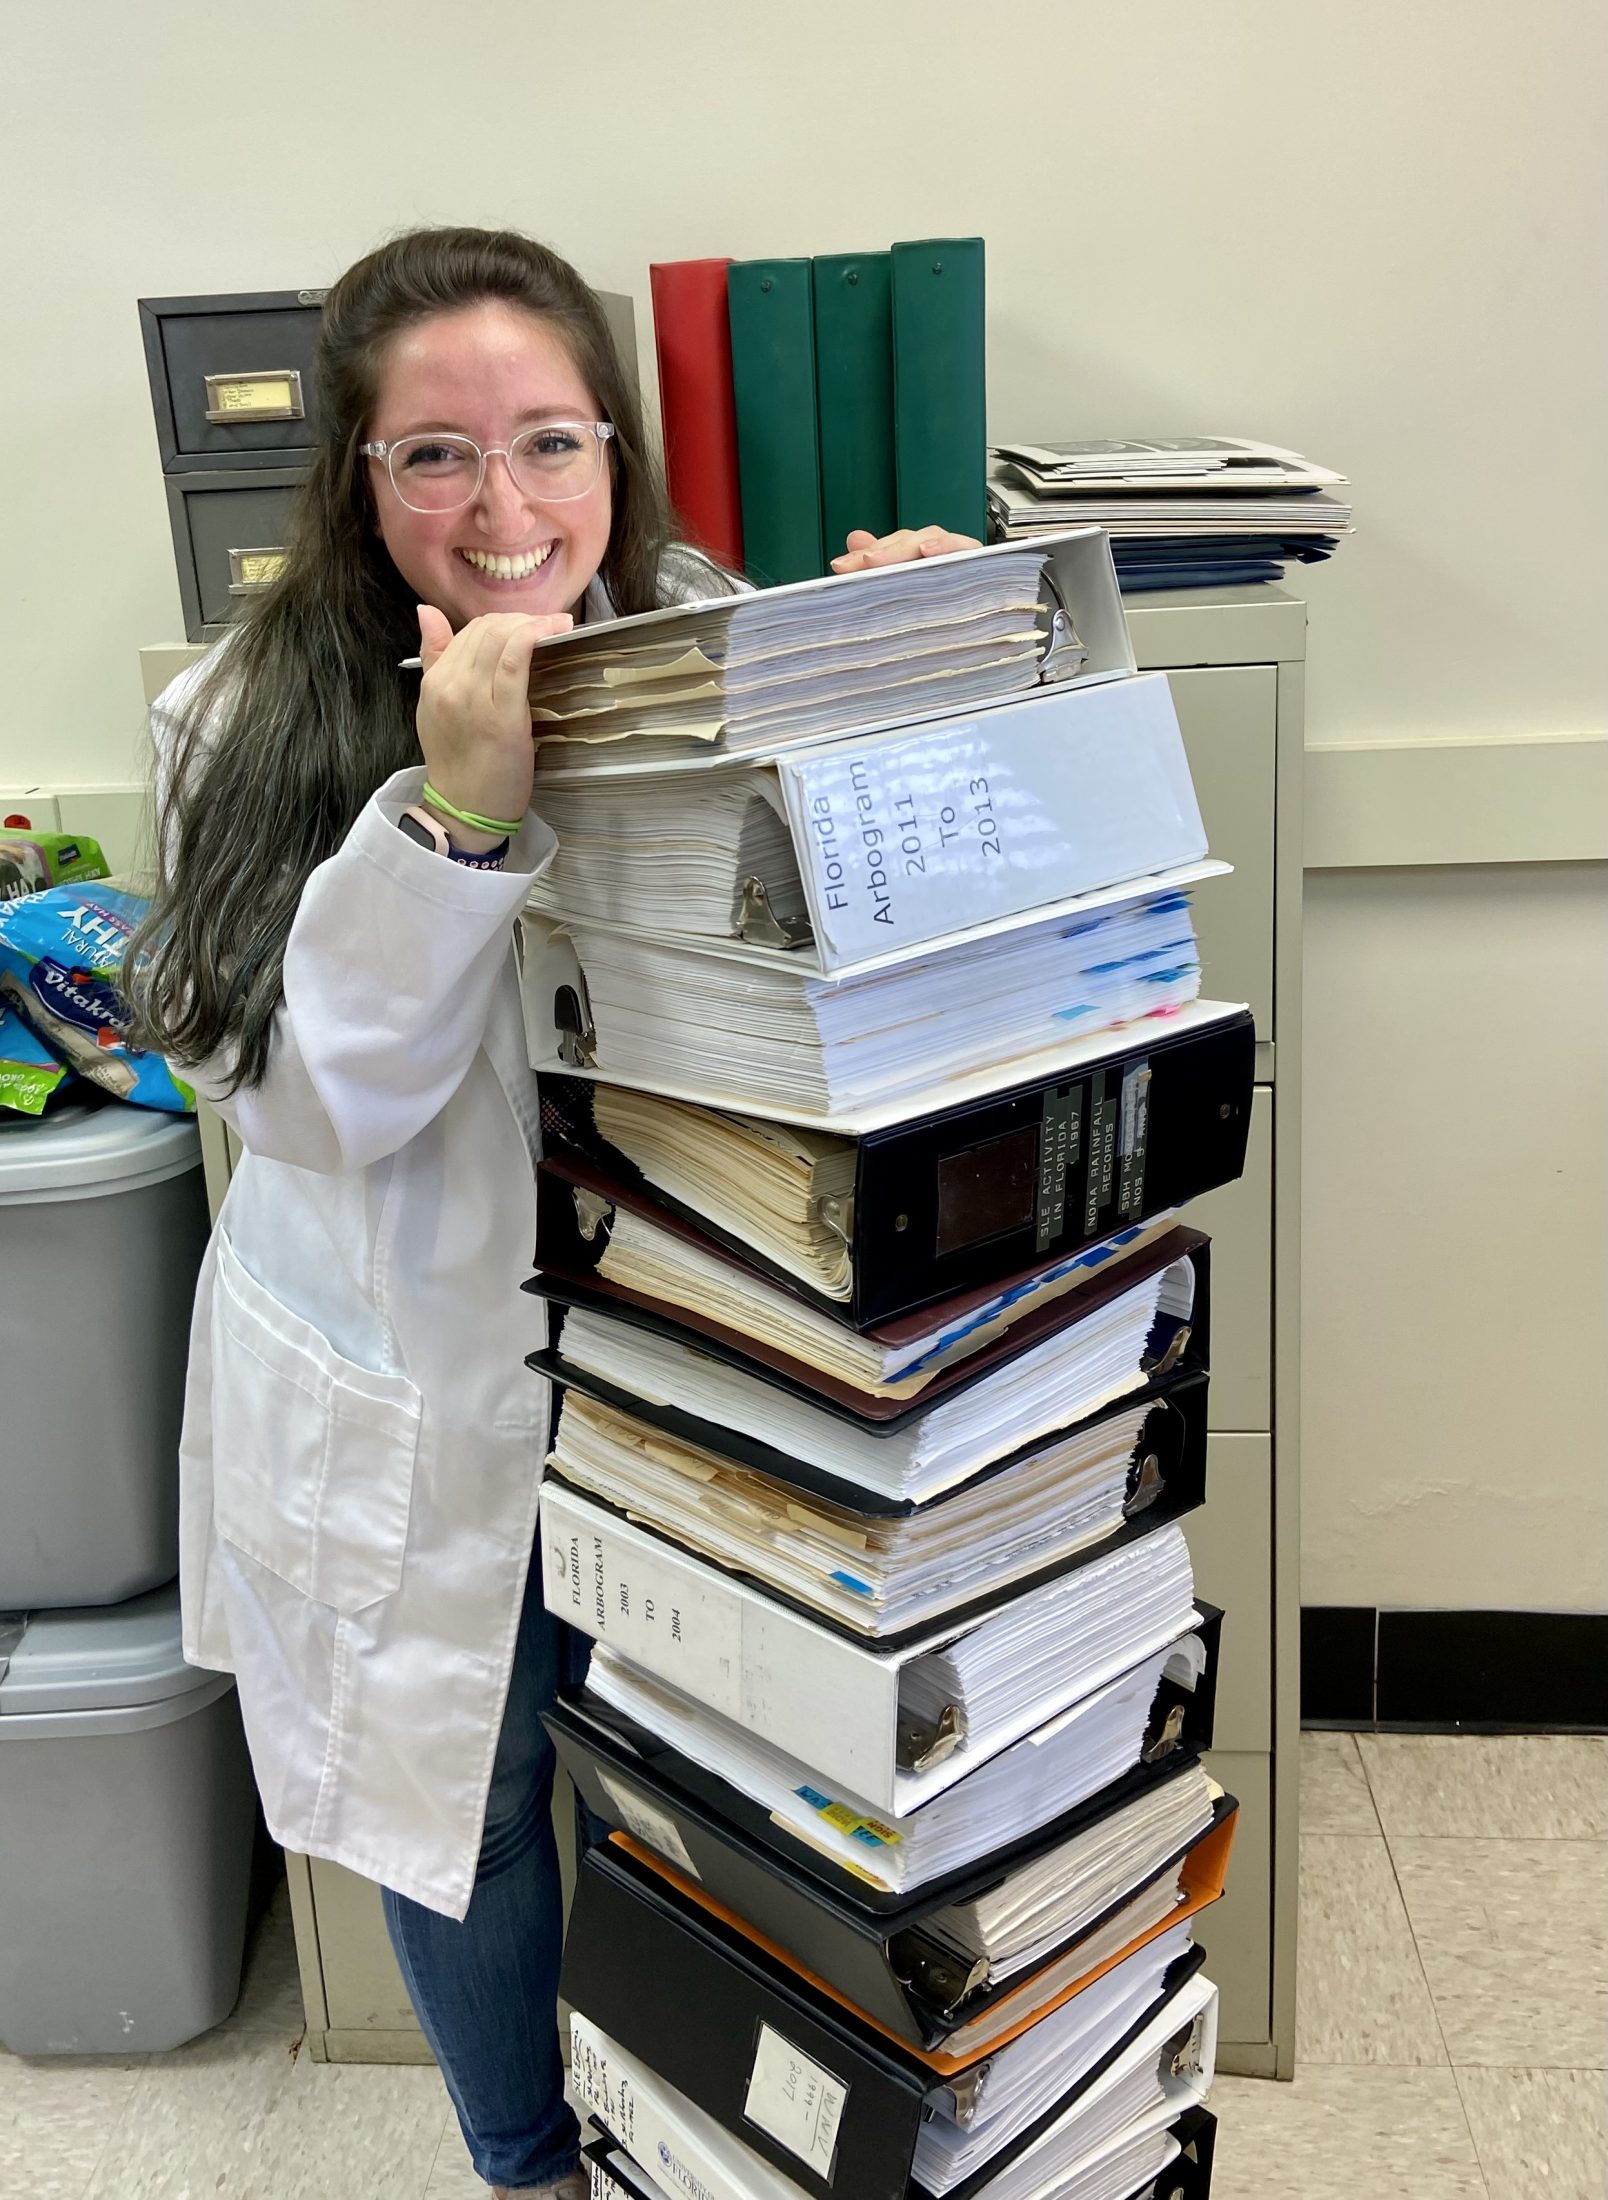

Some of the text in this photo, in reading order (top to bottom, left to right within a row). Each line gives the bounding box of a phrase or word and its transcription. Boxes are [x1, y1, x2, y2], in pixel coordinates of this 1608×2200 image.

[850, 761, 895, 925] Arbogram
[894, 794, 926, 876] 2011
[939, 806, 959, 848] To
[969, 777, 1001, 857] 2013
[813, 796, 848, 911] Florida
[61, 928, 114, 969] ATURAL
[1070, 1111, 1080, 1150] 1967
[1088, 1096, 1103, 1228] NOAA RAINFALL
[1102, 1122, 1114, 1193] RECORDS
[1040, 1114, 1055, 1237] SLE ACTIVITY
[1054, 1120, 1068, 1221] IN FLORIDA
[1121, 1182, 1131, 1211] SBH
[1134, 1168, 1143, 1206] NOS.
[571, 1537, 581, 1606] FLORIDA
[594, 1536, 606, 1631] ARBOGRAM
[620, 1583, 630, 1616] 2003
[645, 1599, 655, 1622] TO
[671, 1608, 681, 1643] 2004
[782, 2060, 802, 2101] 2017
[817, 2092, 838, 2156] WNV
